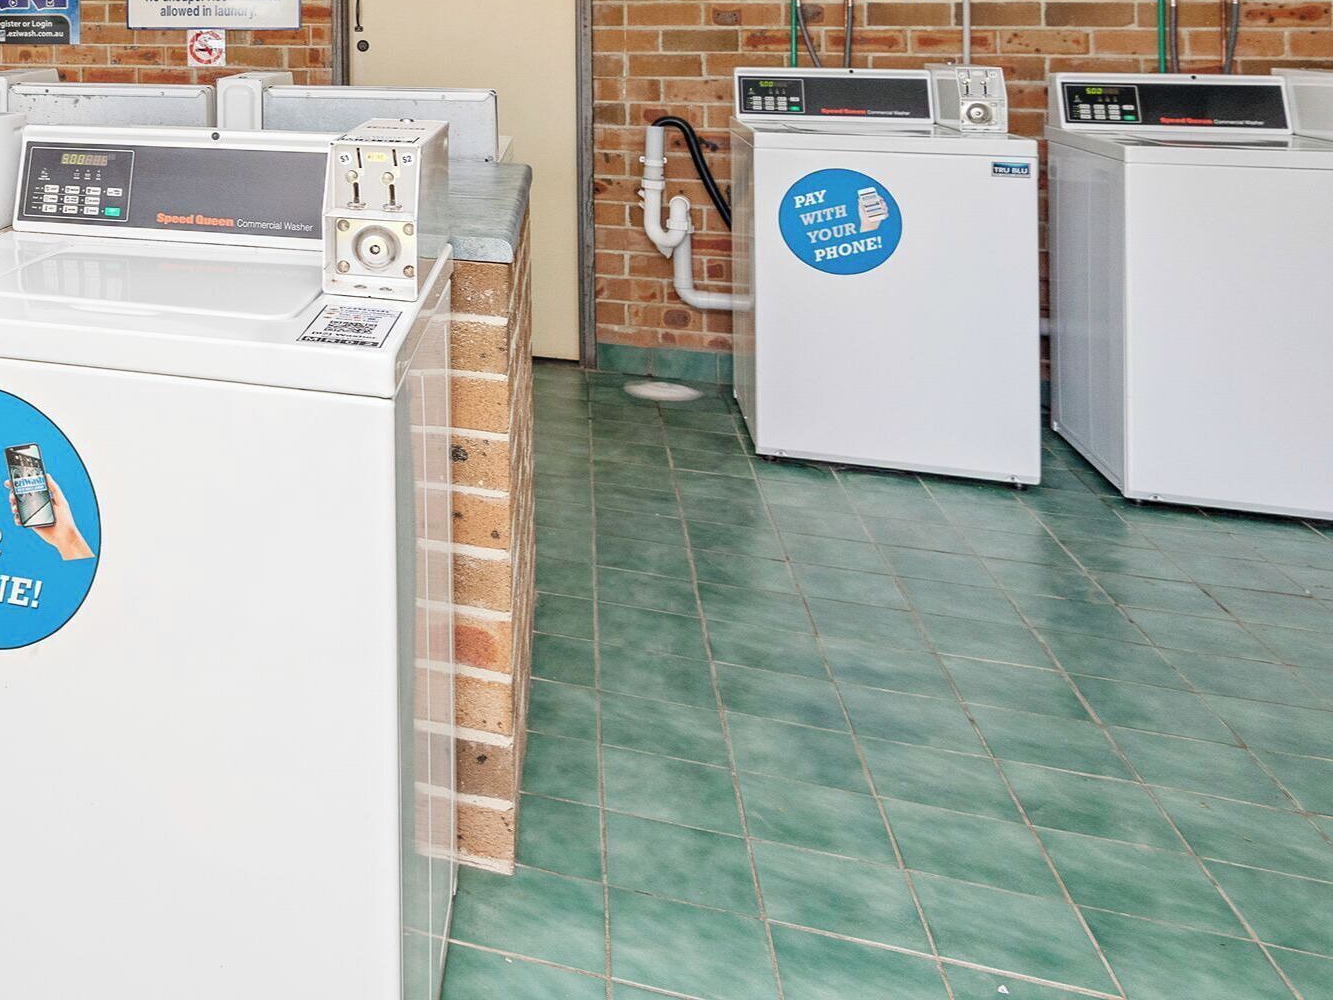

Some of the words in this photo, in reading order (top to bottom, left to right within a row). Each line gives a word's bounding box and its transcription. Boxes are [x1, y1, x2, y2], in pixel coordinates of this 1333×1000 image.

[160, 5, 200, 17] allowed
[202, 5, 212, 16] in
[31, 20, 53, 29] Login
[793, 189, 827, 209] PAY
[156, 211, 194, 225] Speed
[195, 214, 234, 227] Queen
[236, 218, 283, 230] Commercial
[283, 221, 313, 232] Washer
[799, 204, 848, 226] WITH
[806, 222, 857, 244] YOUR
[813, 236, 883, 262] PHONE!
